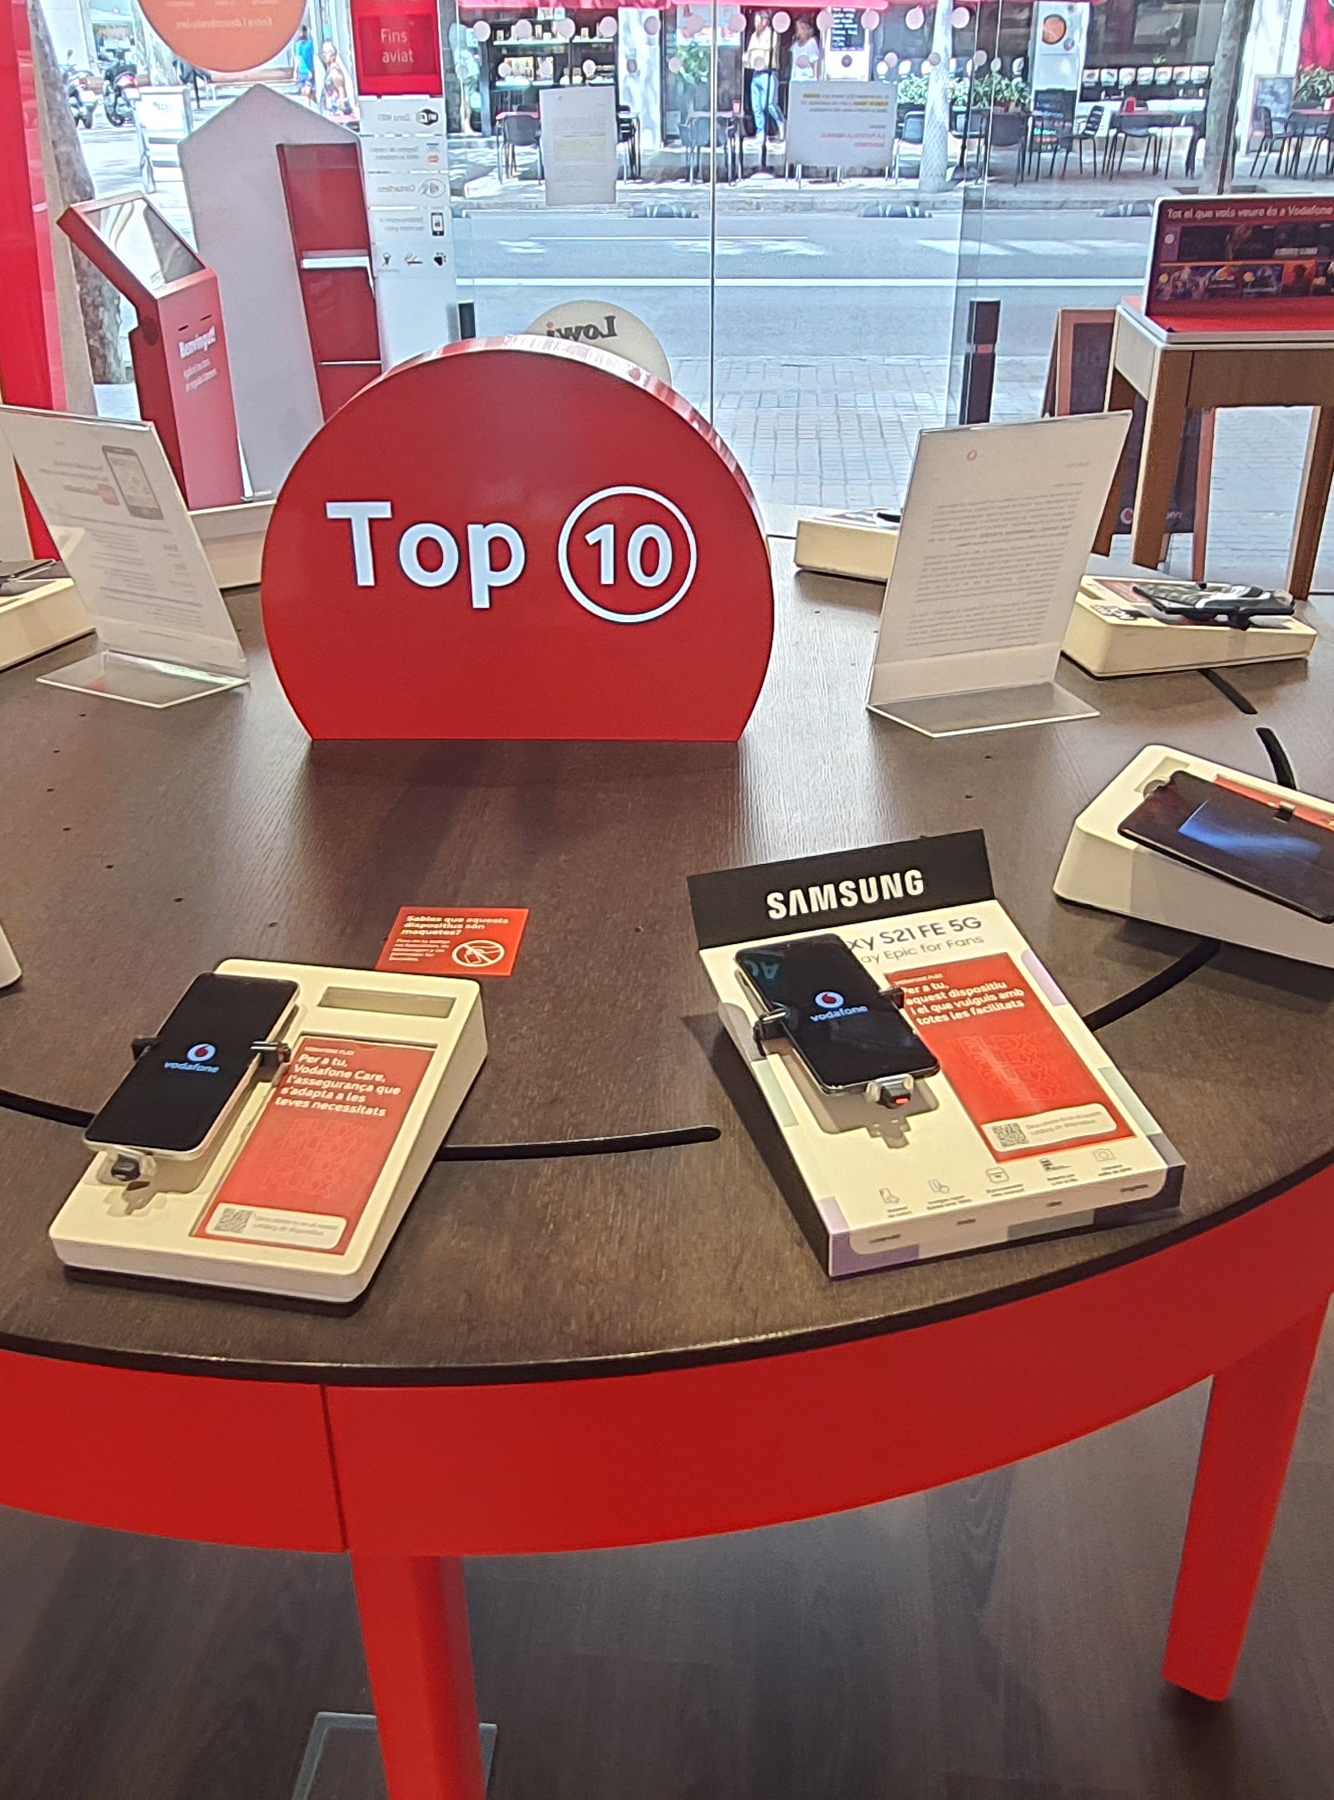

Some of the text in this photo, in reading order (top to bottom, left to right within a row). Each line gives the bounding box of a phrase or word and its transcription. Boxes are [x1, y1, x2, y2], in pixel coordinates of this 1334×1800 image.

[380, 28, 408, 43] Fins
[382, 48, 414, 64] aviat
[1167, 208, 1182, 219] Tot
[1184, 207, 1193, 219] el
[1195, 208, 1213, 220] que
[1215, 206, 1235, 218] vols
[1237, 208, 1264, 218] veure
[1288, 205, 1333, 216] Vodafone
[325, 500, 674, 609] Top 10
[766, 869, 925, 920] SAMSUNG
[443, 916, 465, 925] que
[879, 928, 916, 946] S21
[920, 921, 948, 939] FE
[948, 916, 983, 933] 5G
[884, 946, 917, 964] Epic
[919, 940, 945, 956] for
[946, 935, 985, 951] Fans
[905, 980, 1008, 1006] aquest dispositiu
[917, 1004, 929, 1014] el
[930, 1001, 954, 1014] que
[954, 993, 998, 1010] vulguis
[998, 987, 1025, 1001] amb
[809, 1005, 869, 1022] vodafone
[916, 999, 1025, 1026] totes les facilitats
[164, 1061, 220, 1074] vodafone
[298, 1053, 348, 1068] Per a tu,
[294, 1063, 386, 1083] Vodafone Care,
[280, 1085, 366, 1103] s'adapta a les
[376, 1085, 401, 1096] que
[275, 1096, 387, 1117] teves necessitats
